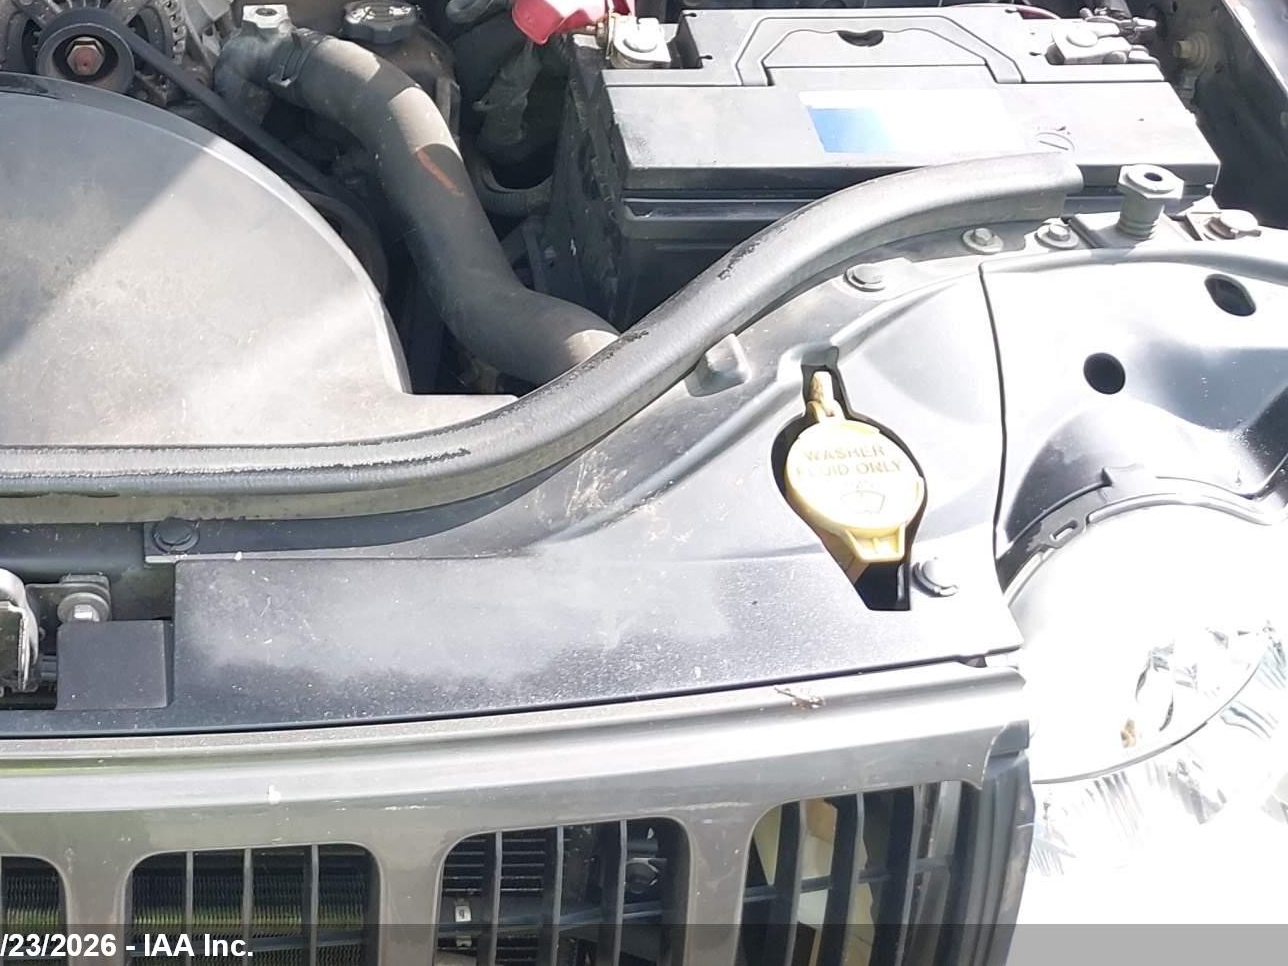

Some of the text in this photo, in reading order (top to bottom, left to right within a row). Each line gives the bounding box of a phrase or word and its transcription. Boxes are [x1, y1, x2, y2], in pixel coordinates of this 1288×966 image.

[803, 444, 886, 462] WASHER
[795, 460, 903, 477] FUID ONLY
